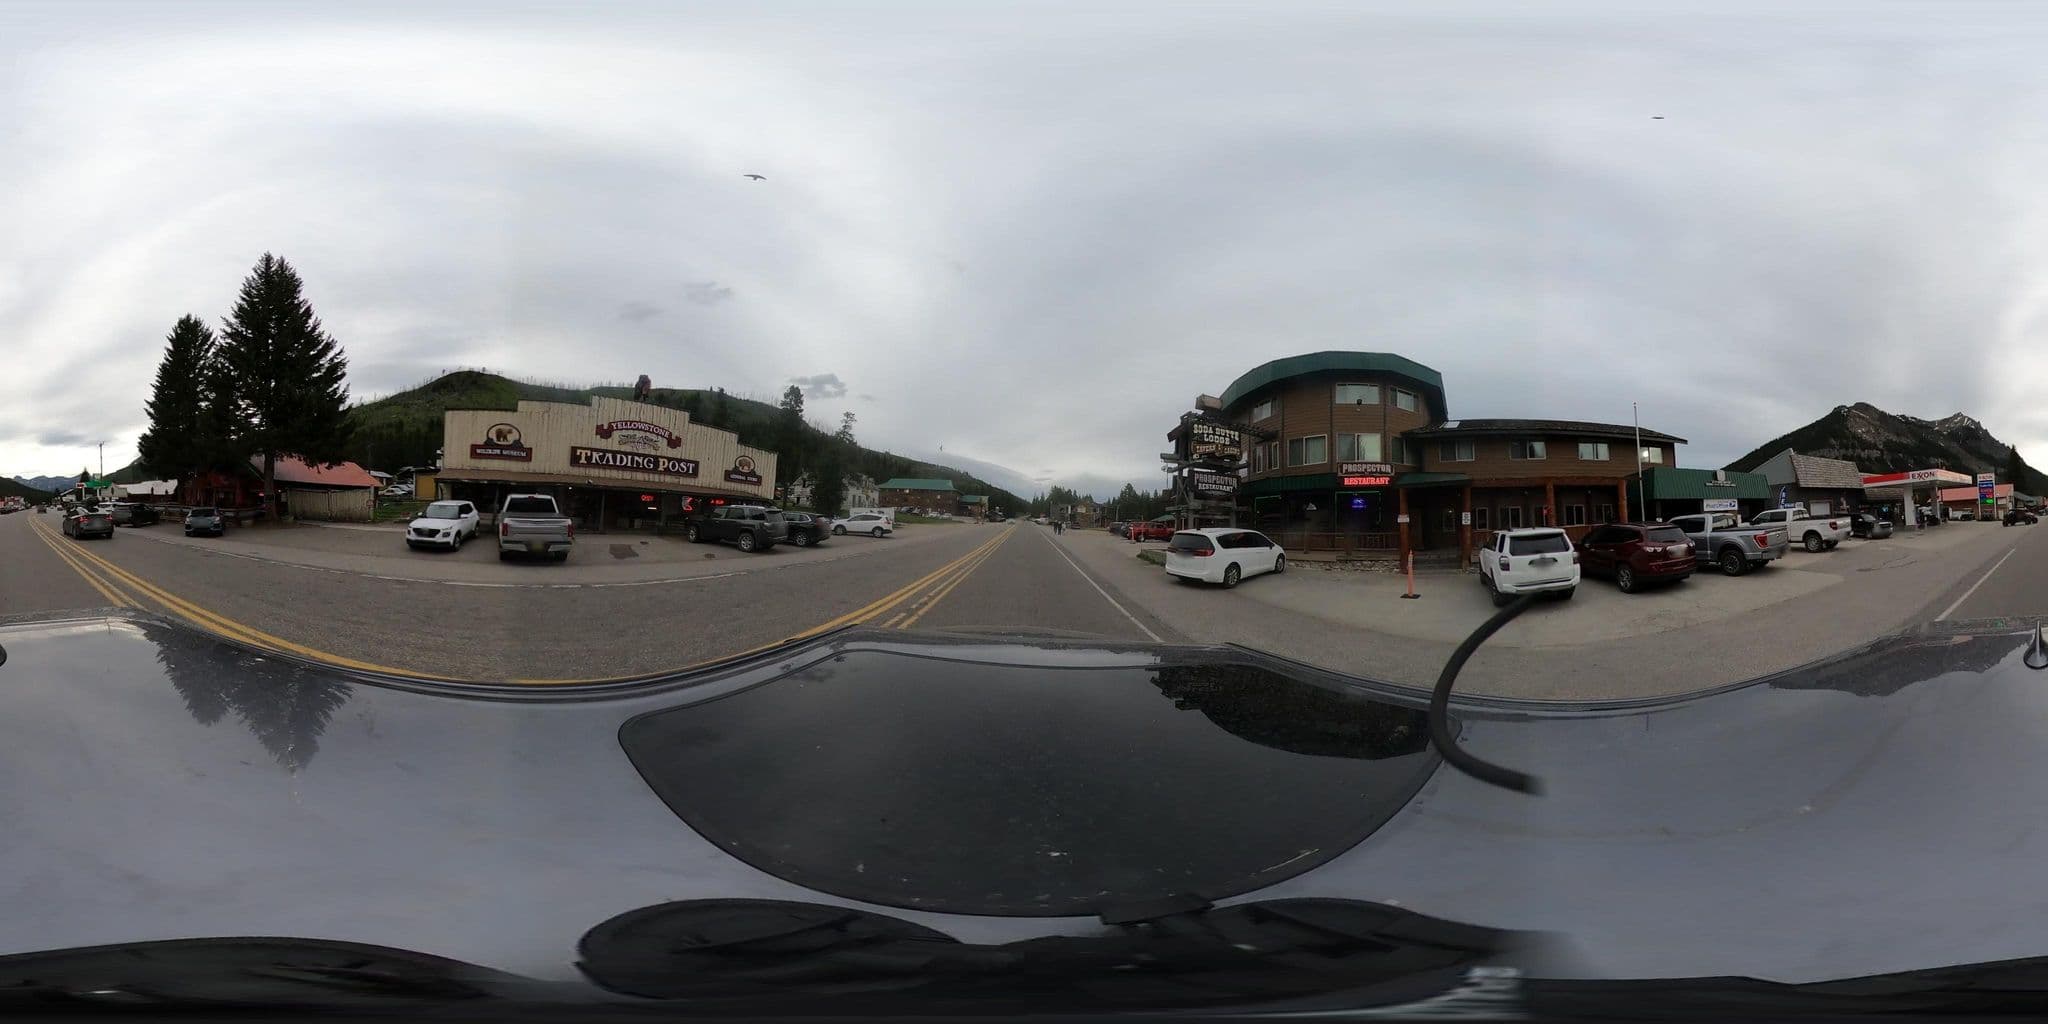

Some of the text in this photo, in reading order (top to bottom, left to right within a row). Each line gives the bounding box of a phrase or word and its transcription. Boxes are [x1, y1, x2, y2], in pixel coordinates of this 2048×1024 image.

[611, 422, 670, 438] YELLOWSTONE
[1193, 424, 1240, 441] SODA BUTTE
[1204, 433, 1230, 445] LODGE
[576, 449, 695, 474] TRADING POST
[1342, 463, 1392, 474] PROSPECTOR
[1194, 473, 1237, 489] PROSPECTOR
[1344, 477, 1390, 485] RESTAURANT
[1911, 471, 1935, 480] EXXON
[1198, 482, 1233, 493] RESTAURANT
